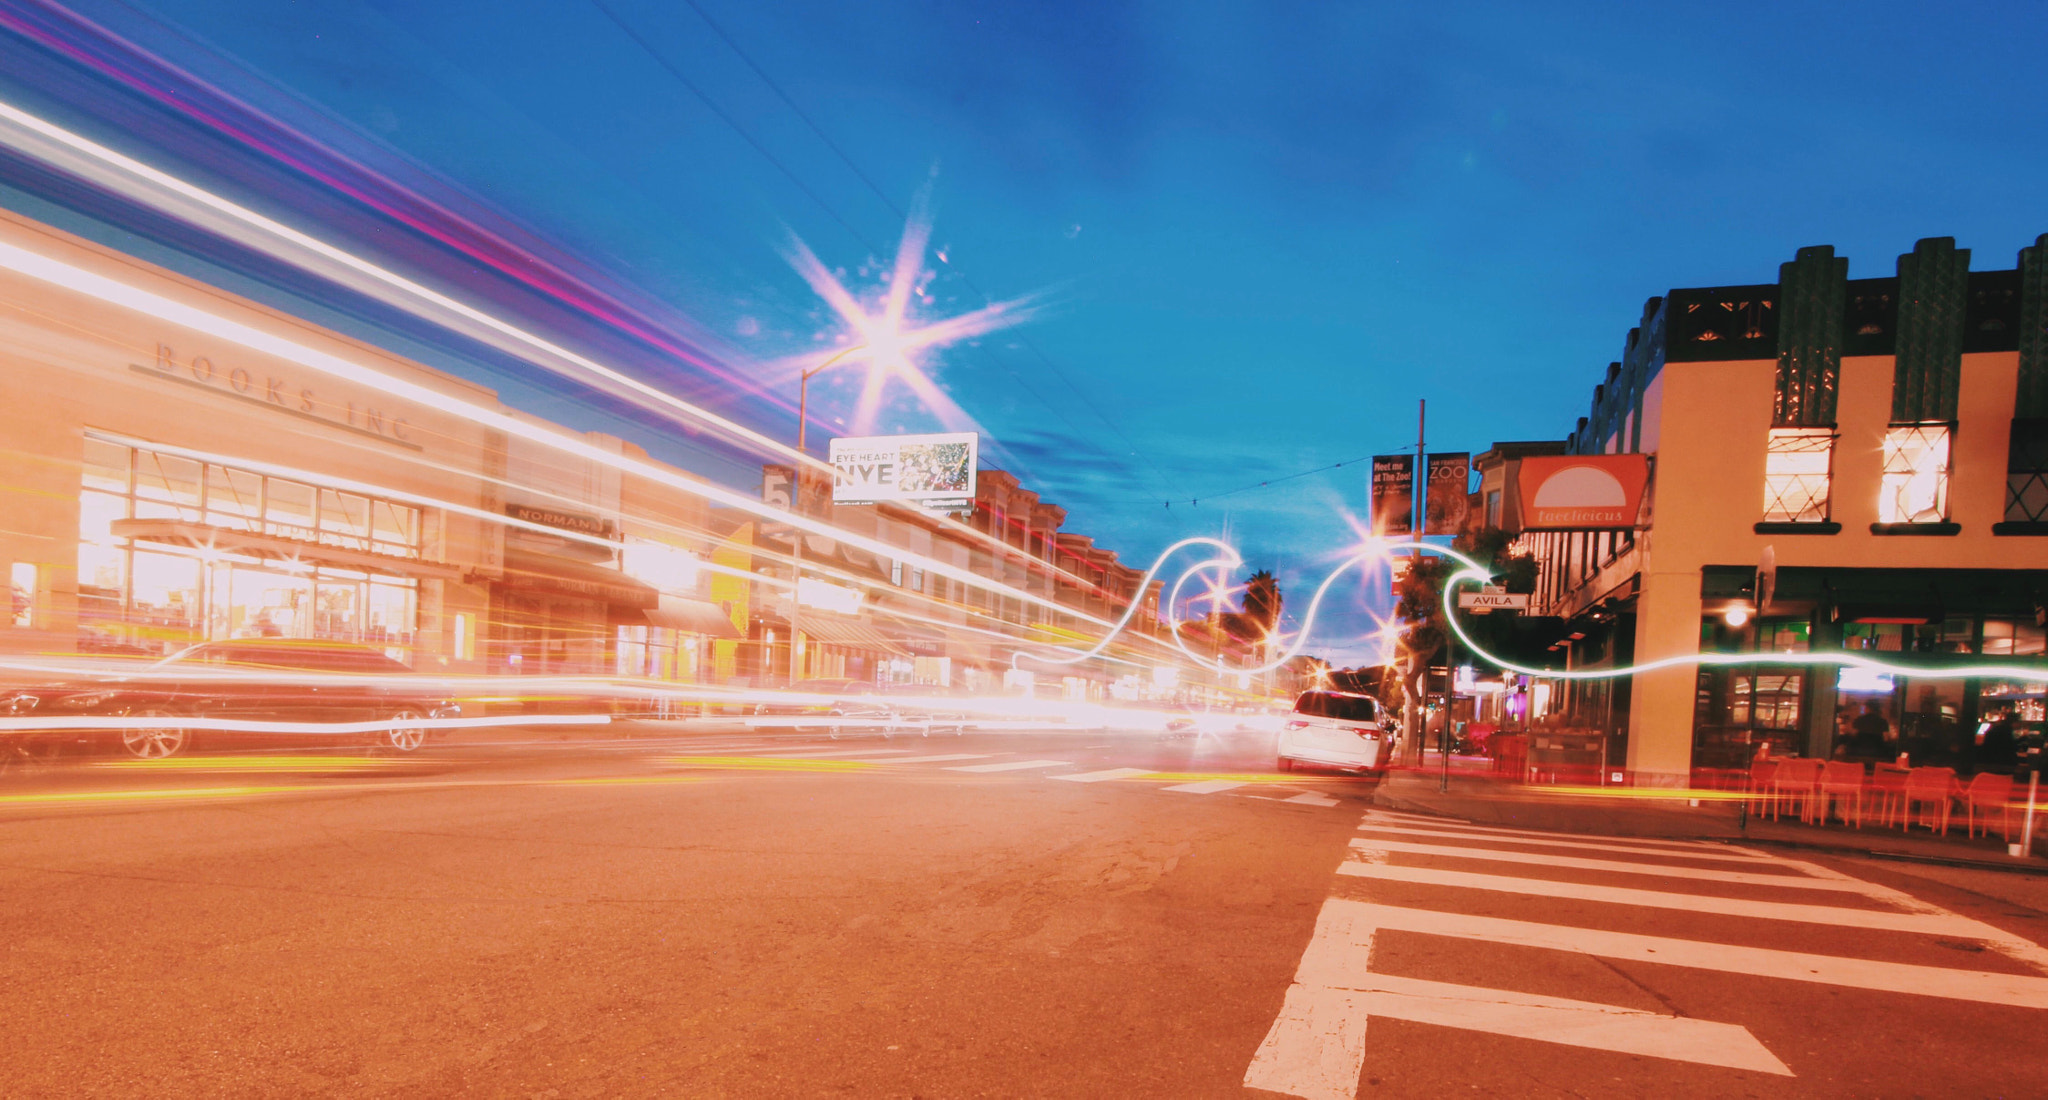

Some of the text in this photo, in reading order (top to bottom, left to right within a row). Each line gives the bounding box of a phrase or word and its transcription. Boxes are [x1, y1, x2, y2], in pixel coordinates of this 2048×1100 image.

[154, 341, 411, 440] BOOKS INC
[836, 452, 895, 463] EYE HEART
[1374, 462, 1391, 471] Meet
[1429, 465, 1467, 479] ZOO
[835, 463, 894, 487] NYE
[1374, 471, 1412, 482] at The Zoo!
[518, 509, 592, 529] NORMAN
[1473, 596, 1513, 605] AVILA
